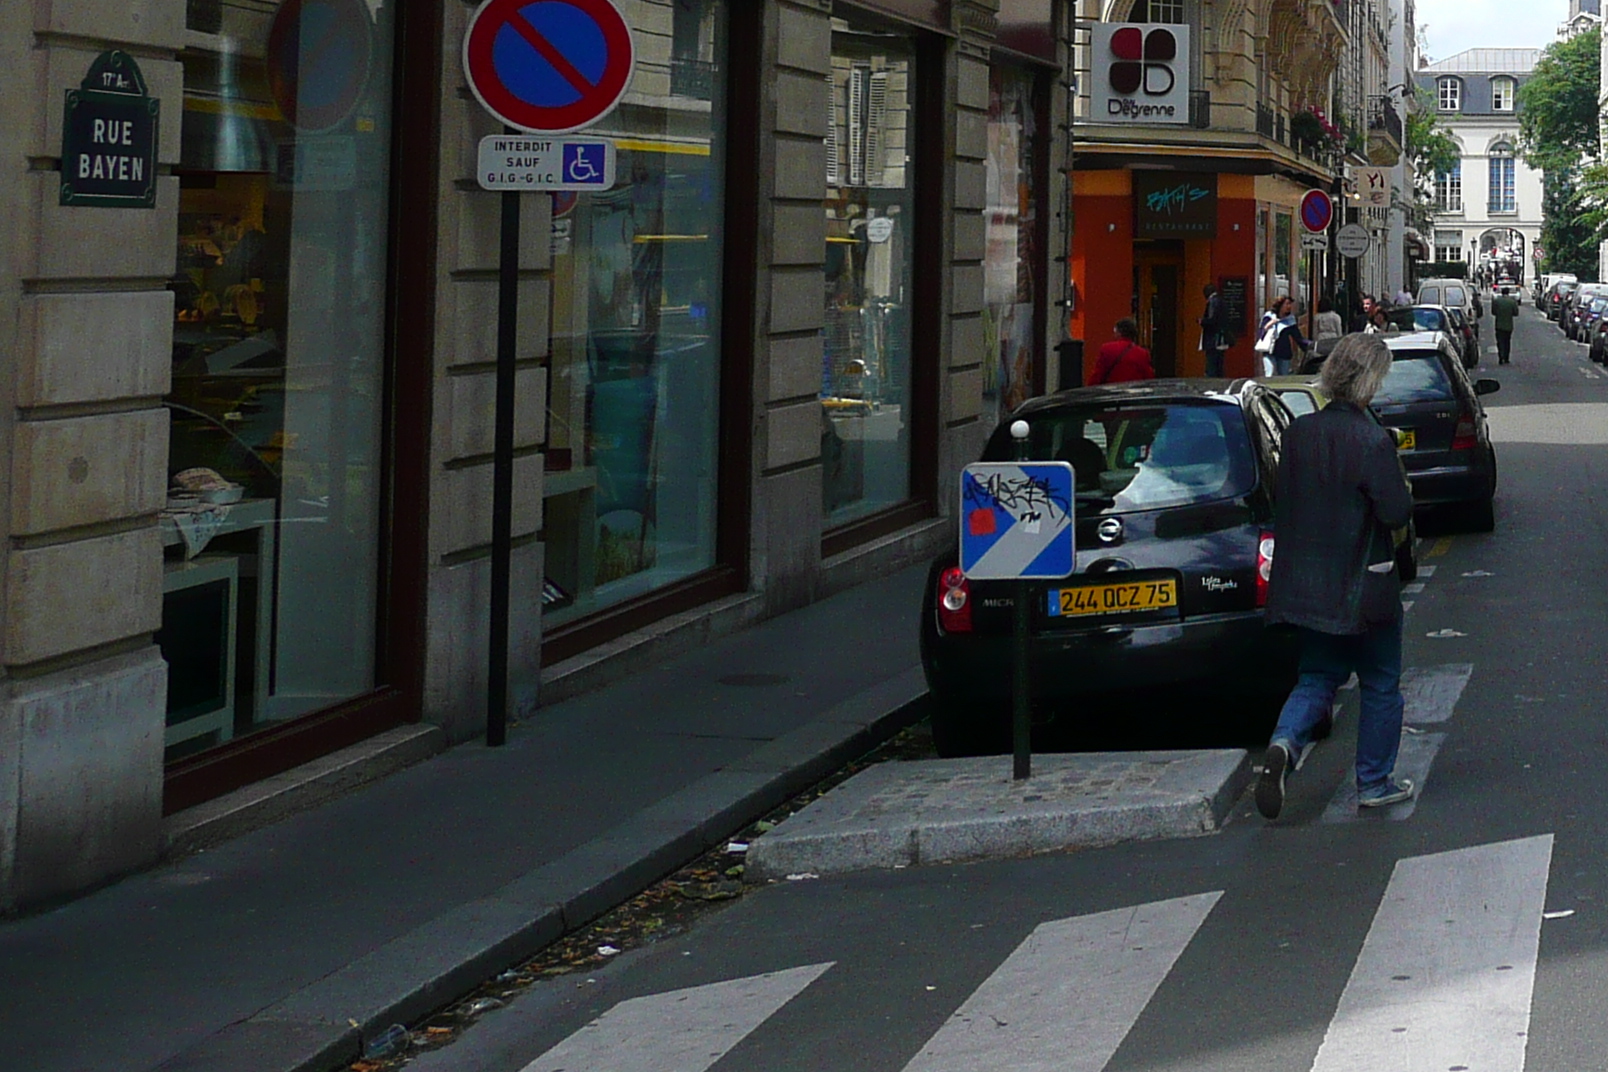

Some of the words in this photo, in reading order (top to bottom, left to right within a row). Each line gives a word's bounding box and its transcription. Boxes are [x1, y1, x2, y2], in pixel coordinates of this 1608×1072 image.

[1107, 98, 1176, 119] Degrenne
[93, 119, 133, 145] RUE
[494, 141, 552, 152] INTERDIT
[78, 154, 143, 181] BAYEN
[506, 157, 540, 168] SAUF
[1061, 590, 1098, 612] 244
[1103, 586, 1141, 608] QCZ
[1146, 583, 1170, 604] 75
